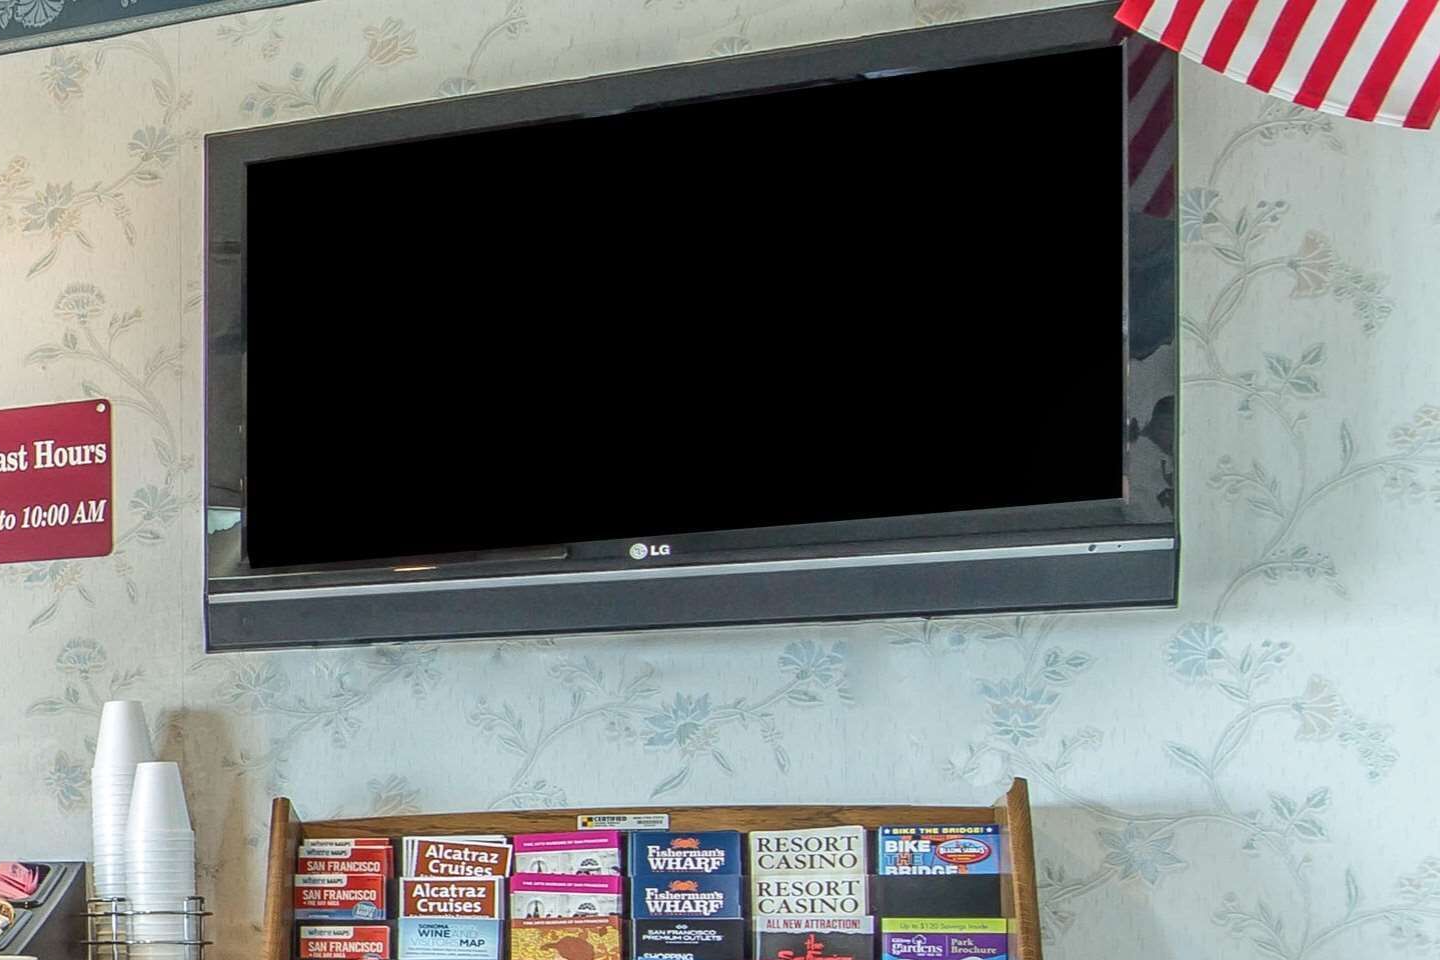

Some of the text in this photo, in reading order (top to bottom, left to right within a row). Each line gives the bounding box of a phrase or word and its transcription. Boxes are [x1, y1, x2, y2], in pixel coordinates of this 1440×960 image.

[33, 440, 106, 469] Hours
[21, 504, 69, 528] 10:00
[72, 500, 106, 524] AM
[650, 545, 671, 556] LG
[757, 835, 859, 853] RESORT
[885, 841, 931, 852] BIKE
[426, 845, 499, 864] Alcatraz
[647, 846, 725, 858] Fisherman's
[307, 861, 380, 872] SAN FRANCISCO
[428, 860, 493, 877] Cruises
[648, 856, 724, 873] WHARF
[758, 853, 858, 870] CASINO
[303, 890, 376, 900] SAN FRANCISCO
[412, 884, 486, 898] Alcatraz
[756, 880, 860, 897] RESORT
[417, 899, 481, 913] Cruises
[646, 899, 723, 916] WHARF
[758, 898, 859, 915] CASINO
[767, 920, 860, 929] ALL NEW ATTRACTION!
[892, 940, 943, 955] gardens
[951, 938, 974, 946] Park
[951, 945, 996, 953] Brochure
